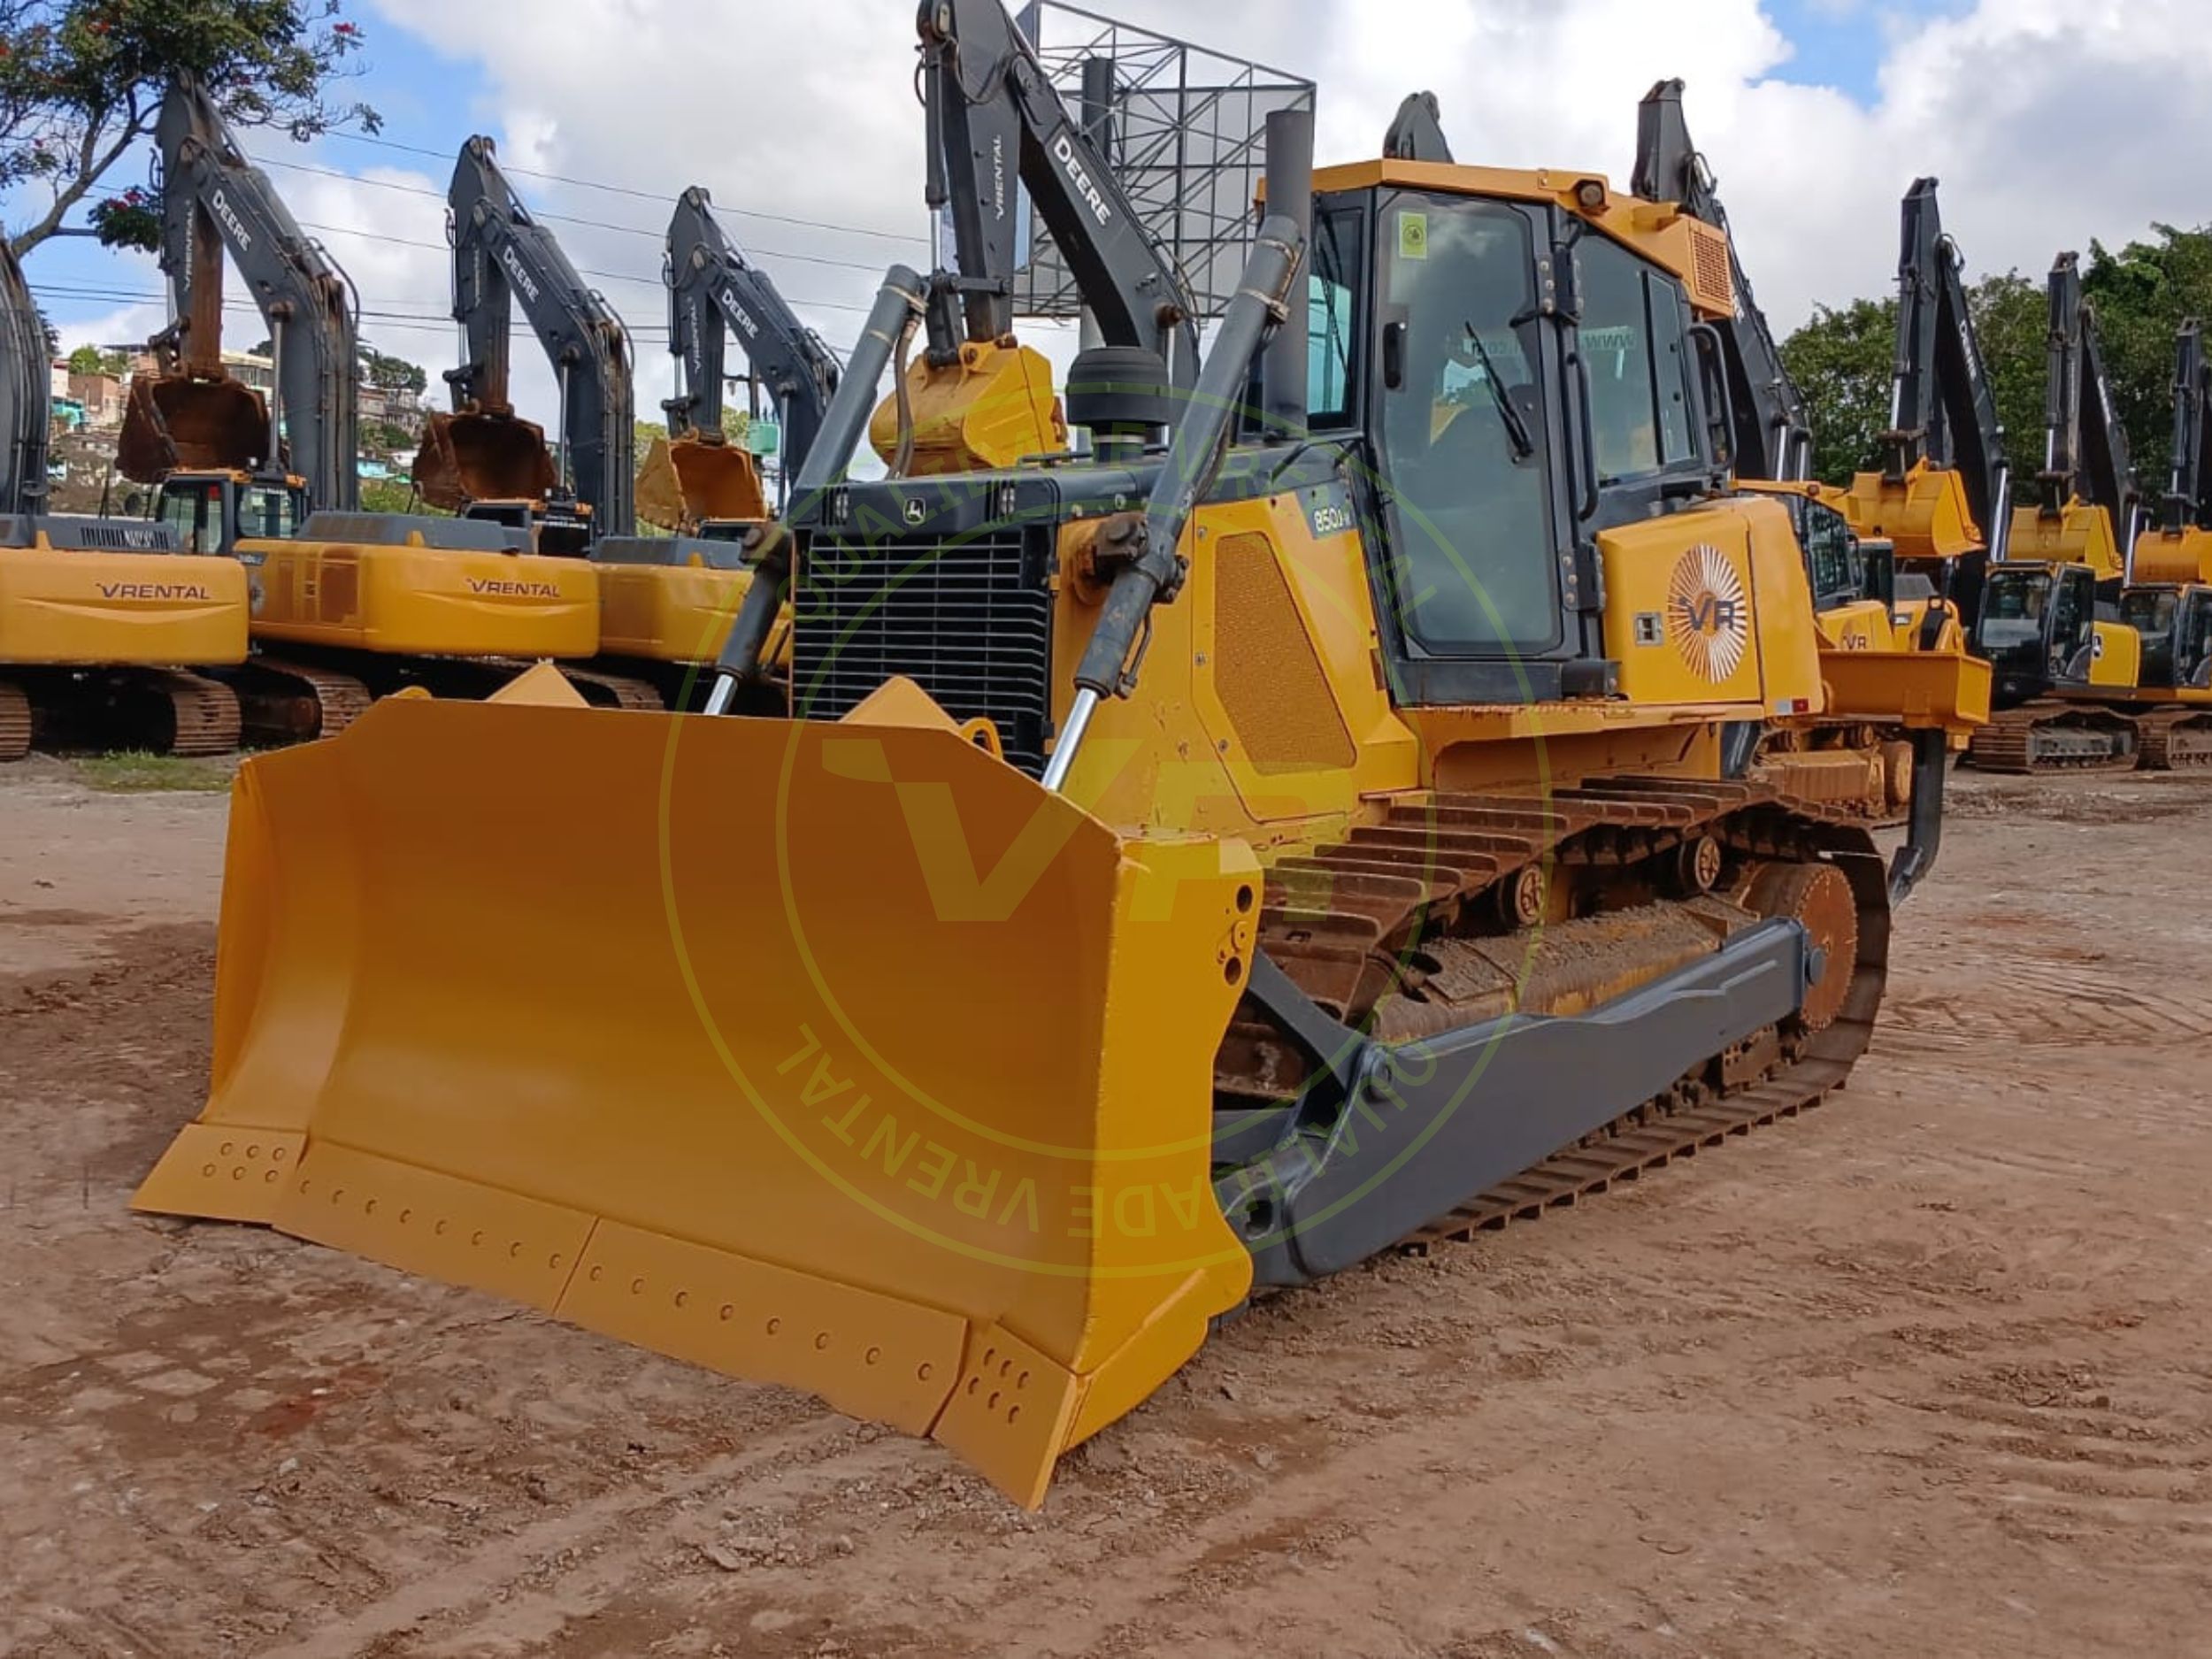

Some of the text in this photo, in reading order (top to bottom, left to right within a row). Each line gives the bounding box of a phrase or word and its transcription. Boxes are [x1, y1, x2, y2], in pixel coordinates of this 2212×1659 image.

[993, 134, 1004, 220] VRENTAL
[1054, 135, 1111, 226] DEERE
[212, 188, 251, 251] DEERE
[503, 245, 540, 303] DEERE
[722, 288, 758, 340] DEERE
[96, 582, 211, 600] VRENTAL
[466, 578, 561, 598] VRENTAL
[1679, 596, 1735, 631] VR
